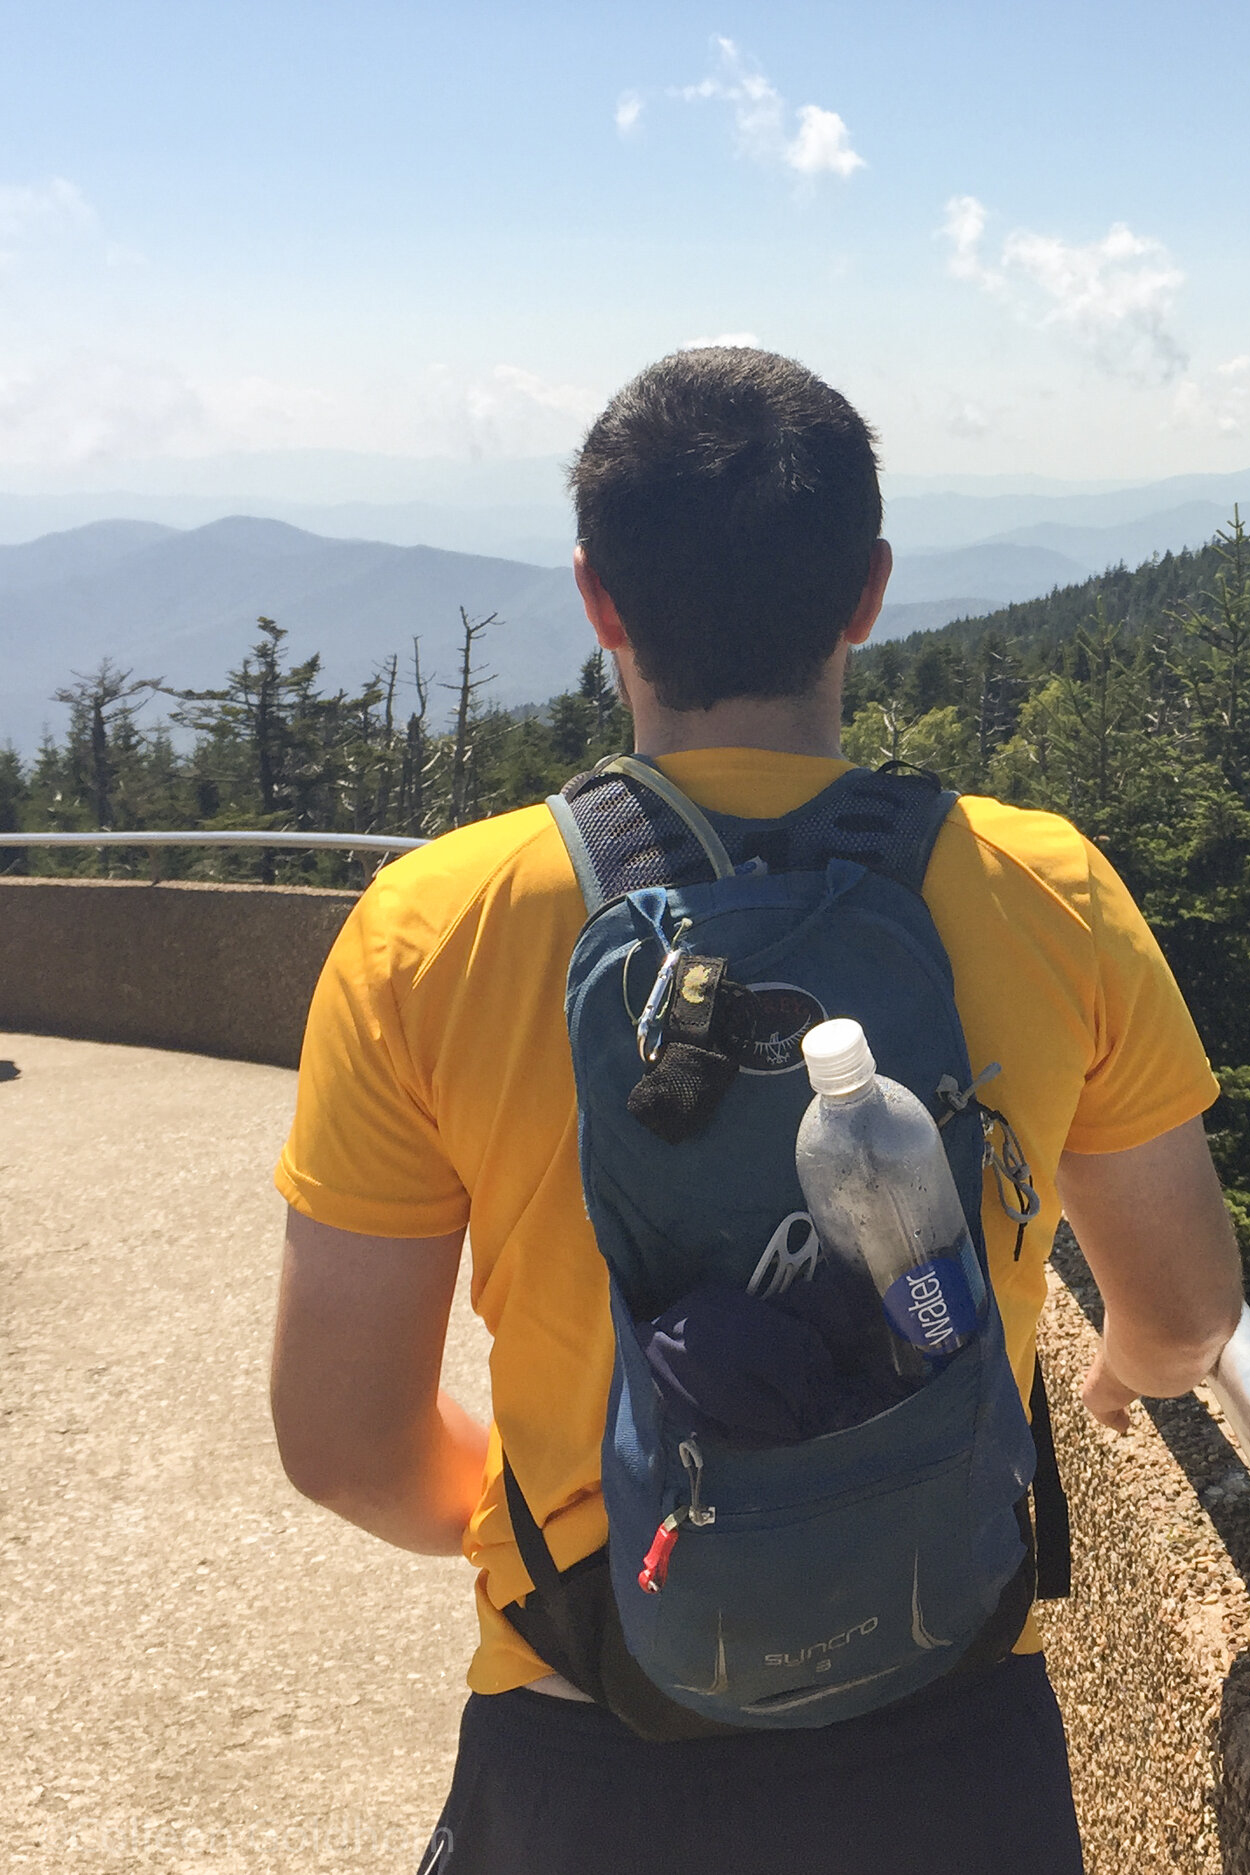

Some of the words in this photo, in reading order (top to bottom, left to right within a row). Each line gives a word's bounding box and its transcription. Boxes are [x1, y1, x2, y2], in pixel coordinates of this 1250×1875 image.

[905, 1269, 954, 1347] water
[763, 1615, 879, 1669] syncro
[814, 1658, 832, 1673] 3
